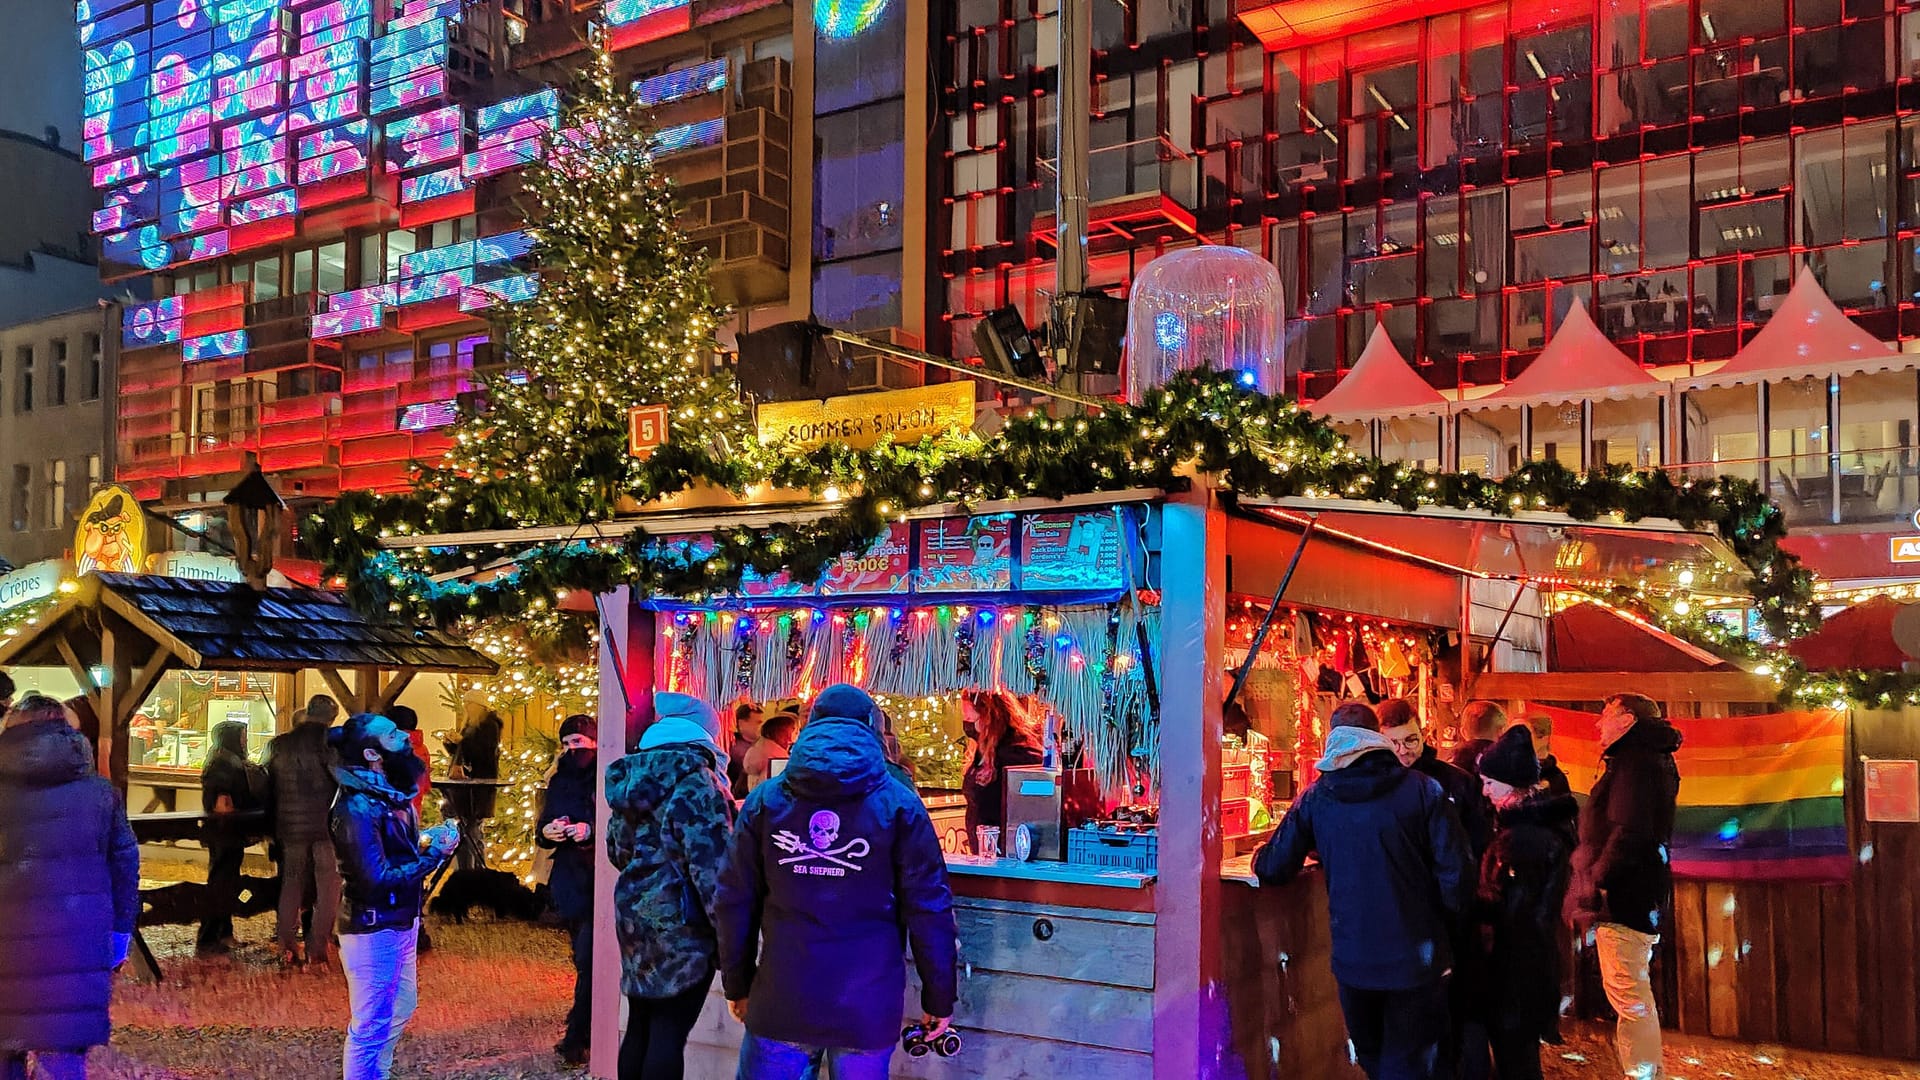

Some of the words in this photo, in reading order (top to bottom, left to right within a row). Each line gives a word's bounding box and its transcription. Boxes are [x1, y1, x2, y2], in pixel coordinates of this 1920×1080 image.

[641, 419, 655, 441] 5
[788, 417, 864, 443] SOMMER
[872, 407, 936, 434] SALON
[845, 557, 889, 573] 3,00€
[0, 576, 40, 604] Crêpes
[793, 864, 808, 874] SEA
[809, 866, 845, 877] SHEPHERD
